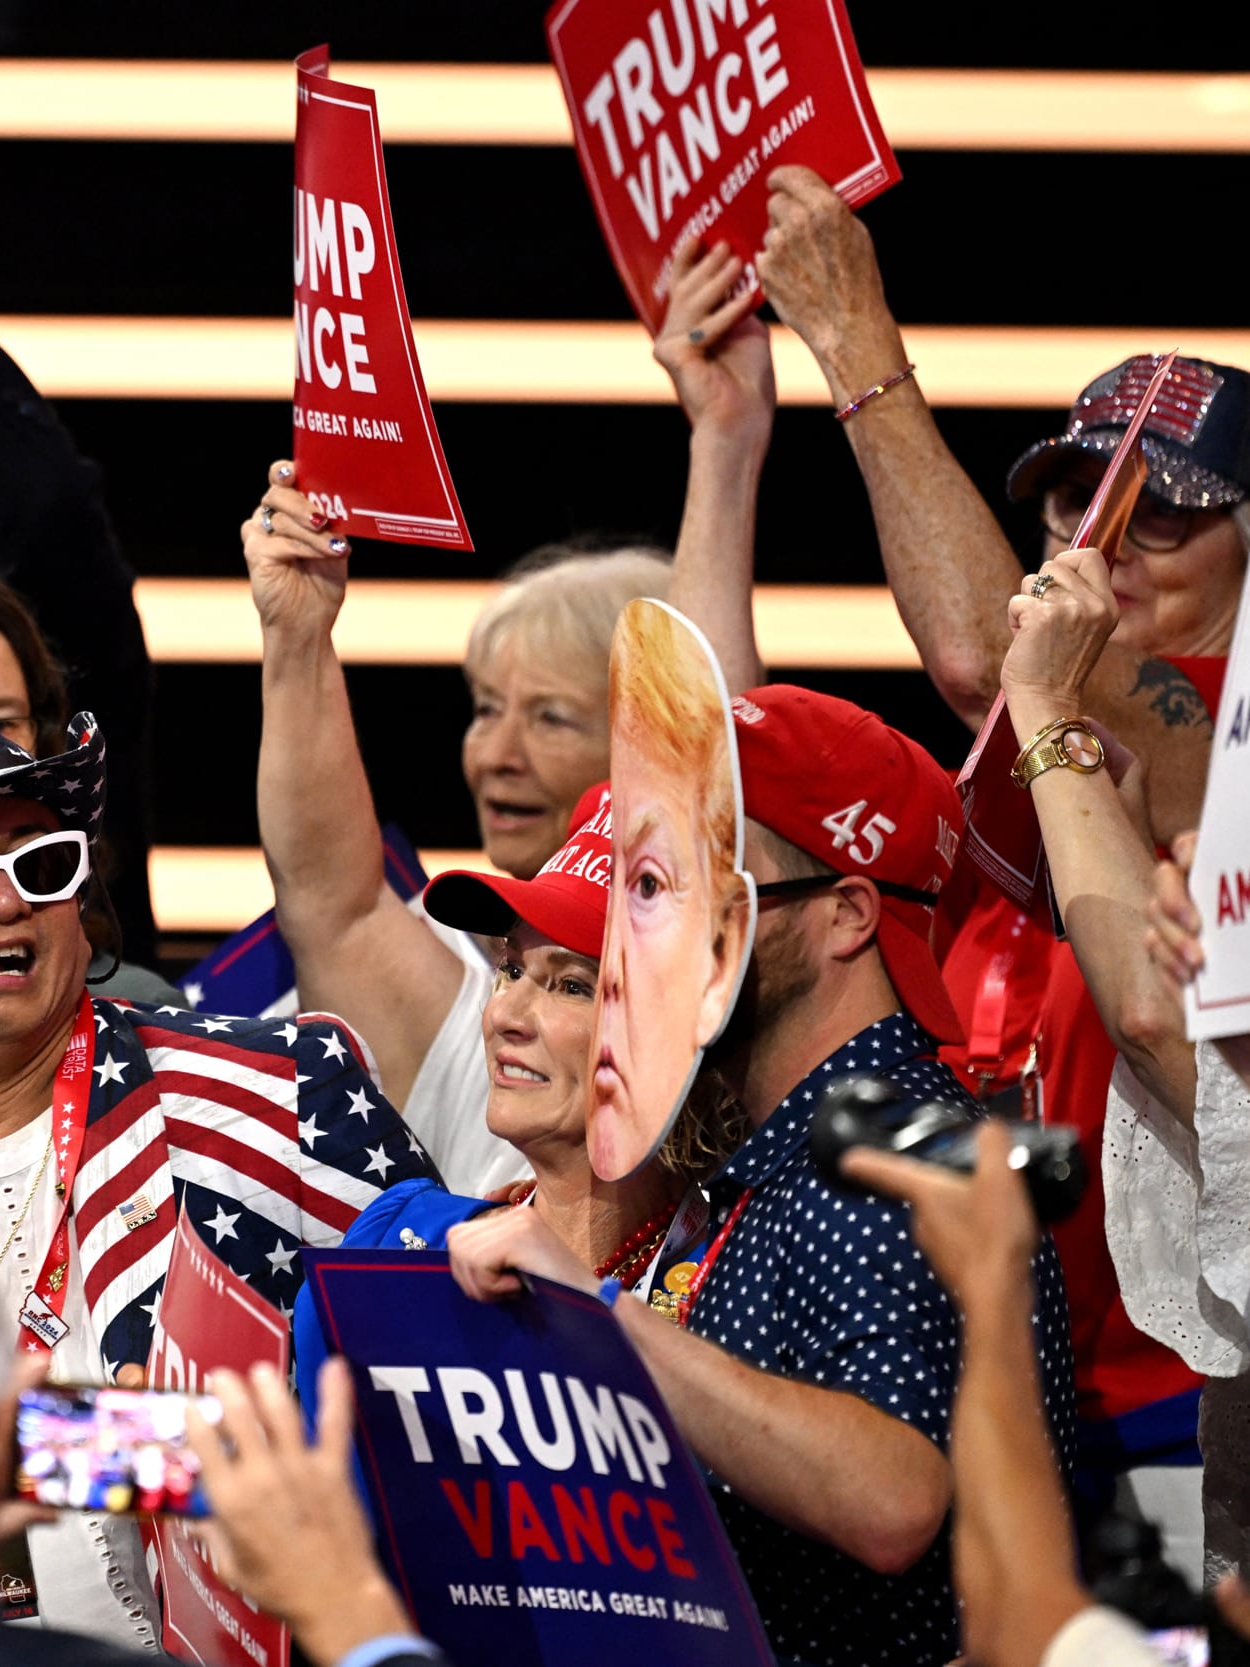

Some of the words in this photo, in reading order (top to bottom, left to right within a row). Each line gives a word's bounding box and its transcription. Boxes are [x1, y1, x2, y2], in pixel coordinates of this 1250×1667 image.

[584, 0, 767, 180] TRUM
[625, 14, 790, 243] VANCE
[719, 147, 761, 205] GREAT
[760, 95, 816, 161] AGAIN!
[307, 409, 348, 437] GREAT
[352, 416, 404, 444] AGAIN!
[821, 799, 897, 866] 45
[565, 849, 612, 889] AG
[61, 1050, 76, 1081] TRUST
[74, 1048, 87, 1073] DATA
[368, 1365, 671, 1490] TRUMP
[439, 1478, 698, 1580] VANCE
[448, 1583, 509, 1609] MAKE
[516, 1585, 606, 1614] AMERICA
[608, 1592, 668, 1619] GREAT
[673, 1601, 730, 1632] AGAIN!
